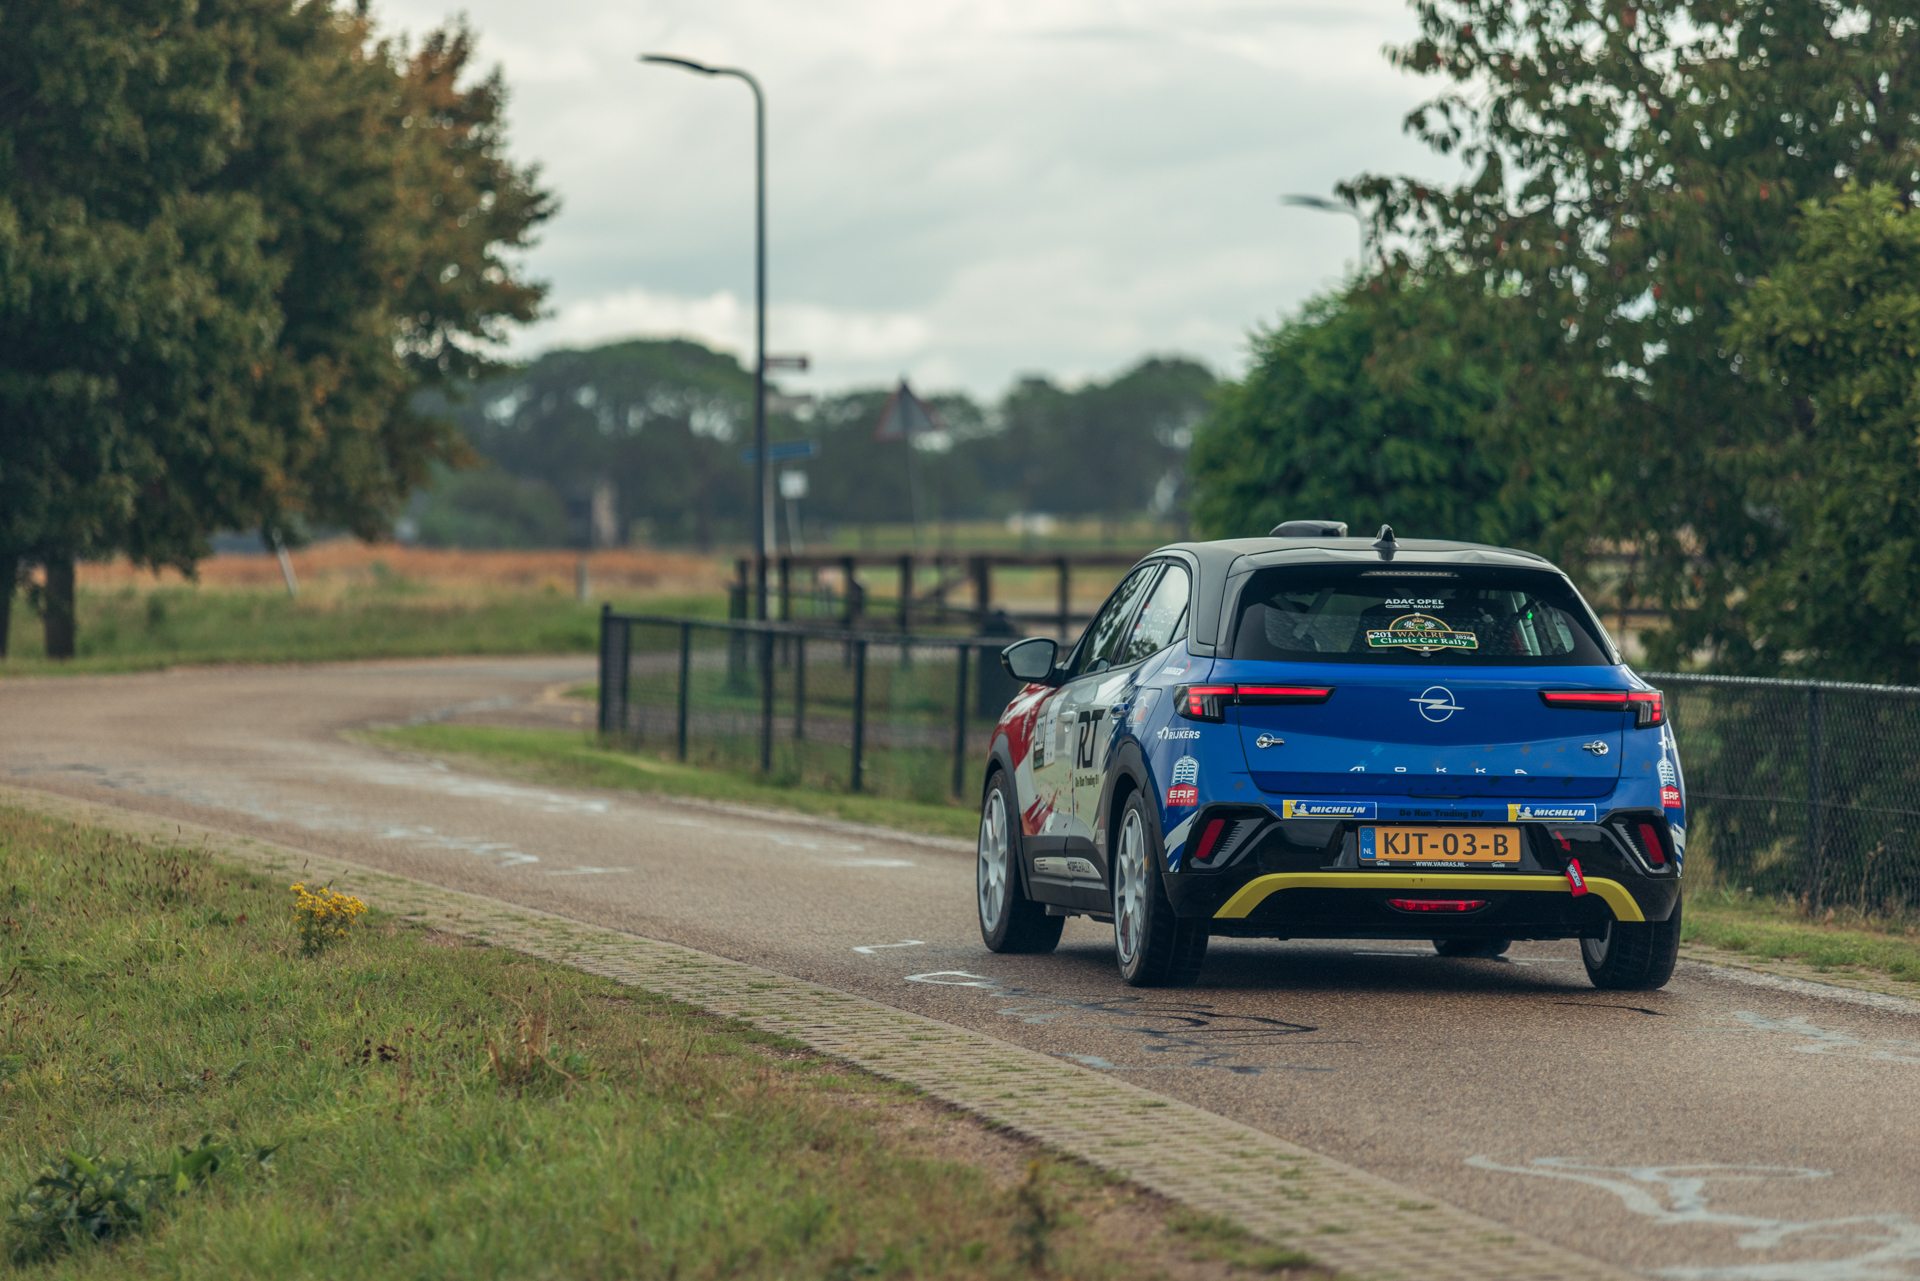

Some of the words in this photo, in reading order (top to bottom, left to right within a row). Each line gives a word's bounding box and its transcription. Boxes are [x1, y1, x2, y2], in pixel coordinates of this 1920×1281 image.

[1396, 631, 1446, 639] WAALRE
[1441, 637, 1468, 646] Rally
[1168, 730, 1201, 739] RIJKERS
[1349, 765, 1528, 776] MOKKA
[1169, 789, 1196, 799] ERF
[1662, 790, 1679, 800] ERF
[1309, 806, 1366, 814] MICHELIN
[1399, 809, 1412, 817] De
[1414, 809, 1432, 817] Run
[1434, 809, 1469, 819] Trading
[1470, 810, 1484, 818] BV
[1533, 808, 1587, 817] MICHELIN
[1383, 832, 1509, 856] KJT-03-B
[1363, 847, 1373, 855] NL
